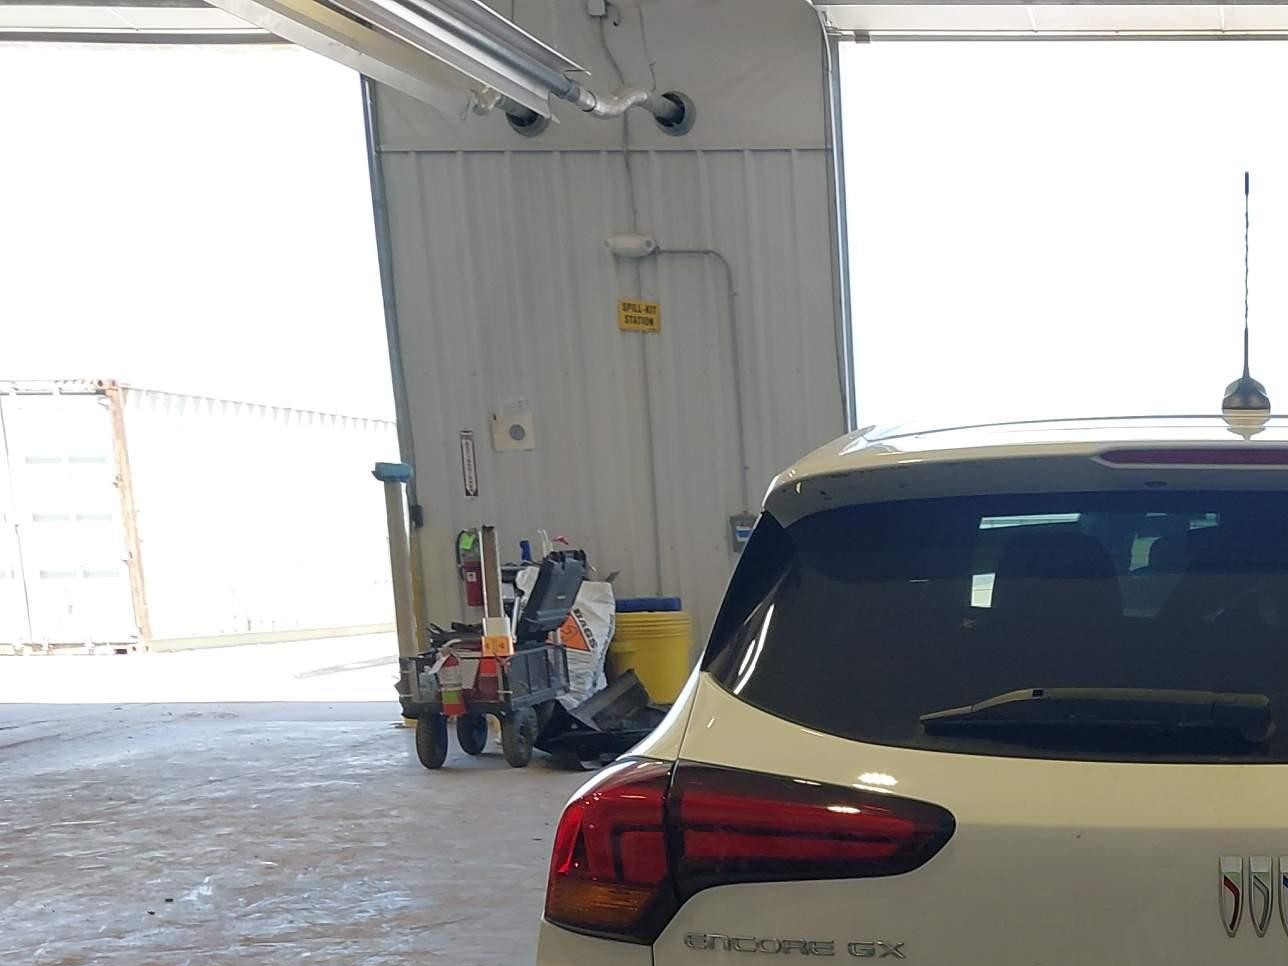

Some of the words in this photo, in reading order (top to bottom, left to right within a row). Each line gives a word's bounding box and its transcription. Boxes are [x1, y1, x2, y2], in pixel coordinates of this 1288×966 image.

[624, 315, 654, 326] STATION
[684, 932, 835, 957] ENCORE
[847, 940, 907, 959] GX
